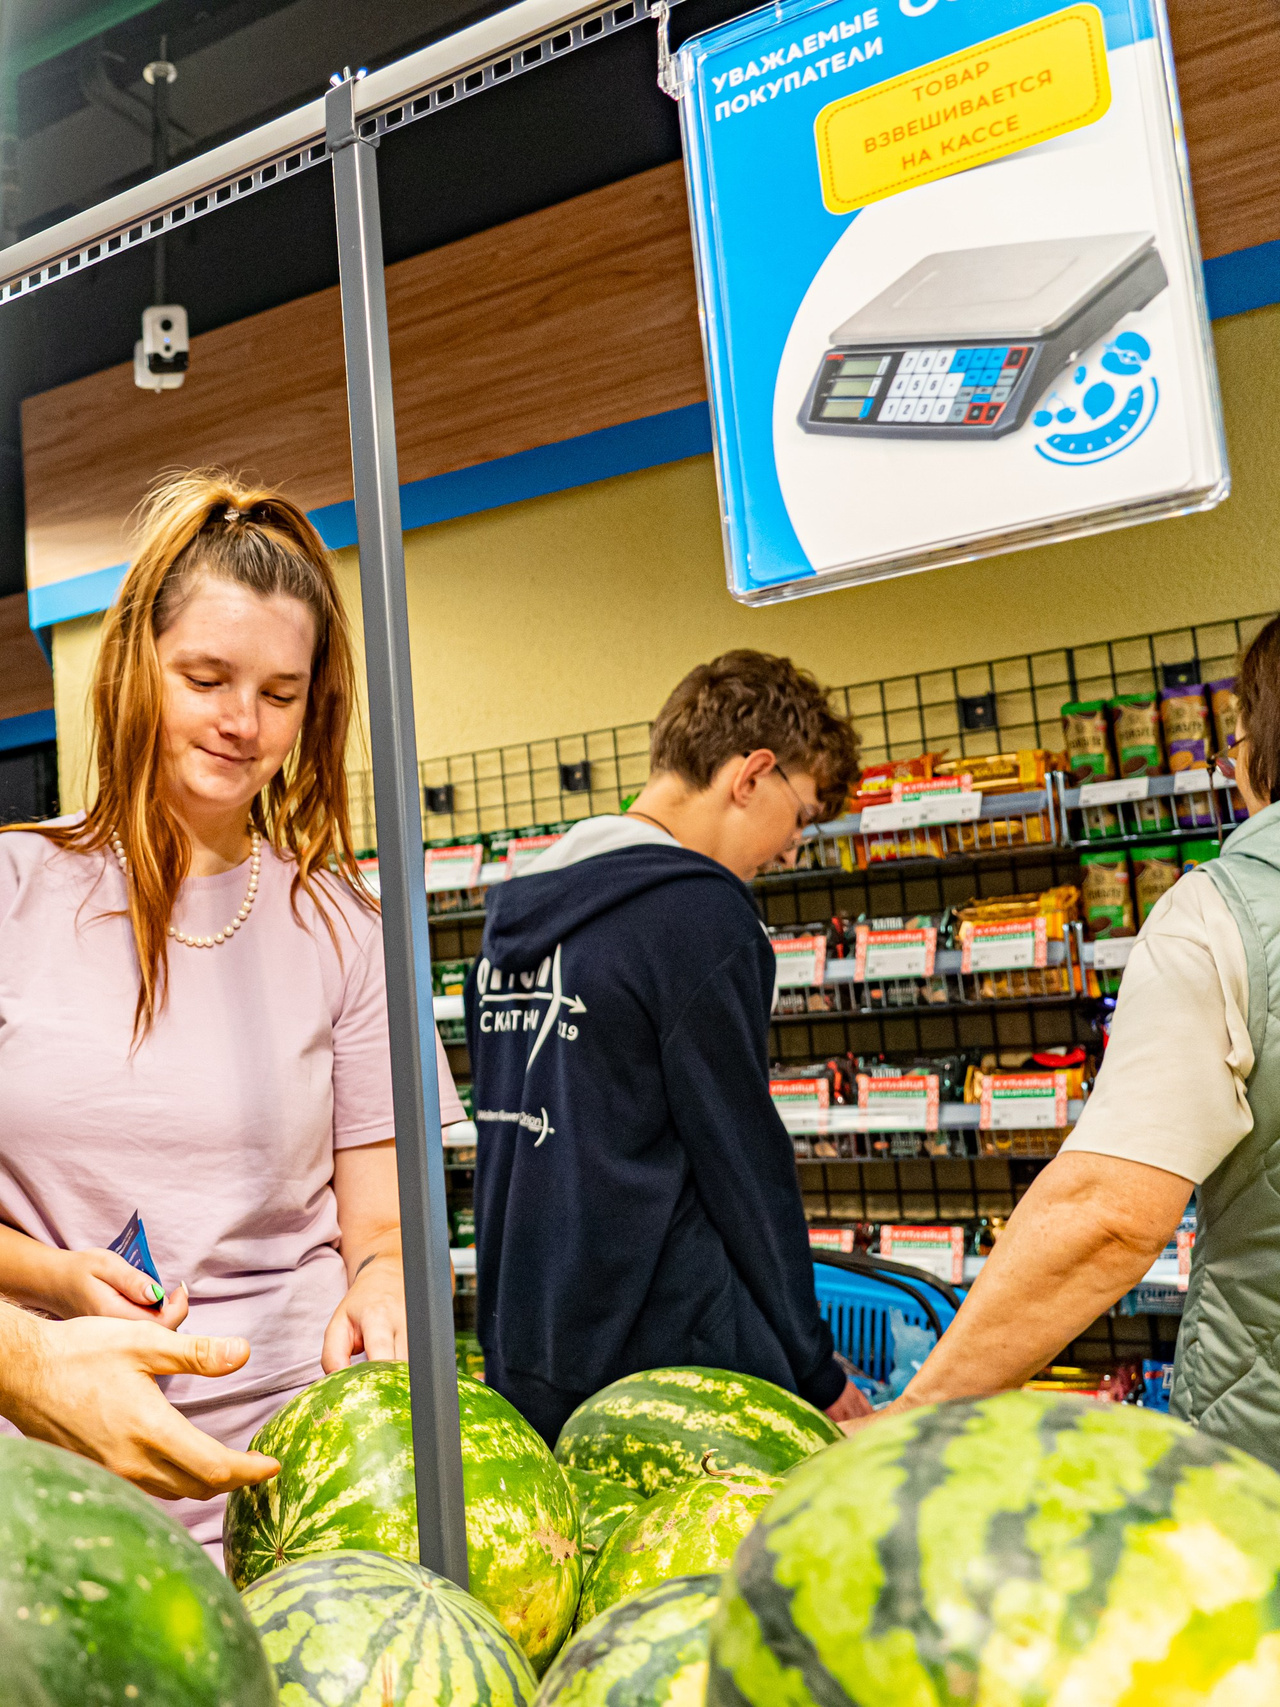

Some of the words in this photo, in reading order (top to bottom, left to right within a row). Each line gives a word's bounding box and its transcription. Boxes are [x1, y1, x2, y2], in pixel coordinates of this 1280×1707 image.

[711, 7, 880, 94] УВАЖАЕМЫЕ
[715, 36, 884, 122] ПОКУПАТЕЛИ
[912, 61, 990, 102] ТОВАР
[864, 69, 1053, 154] ВЗВЕШИВАЕТСЯ
[901, 149, 932, 171] НА
[940, 115, 1020, 154] КАССЕ
